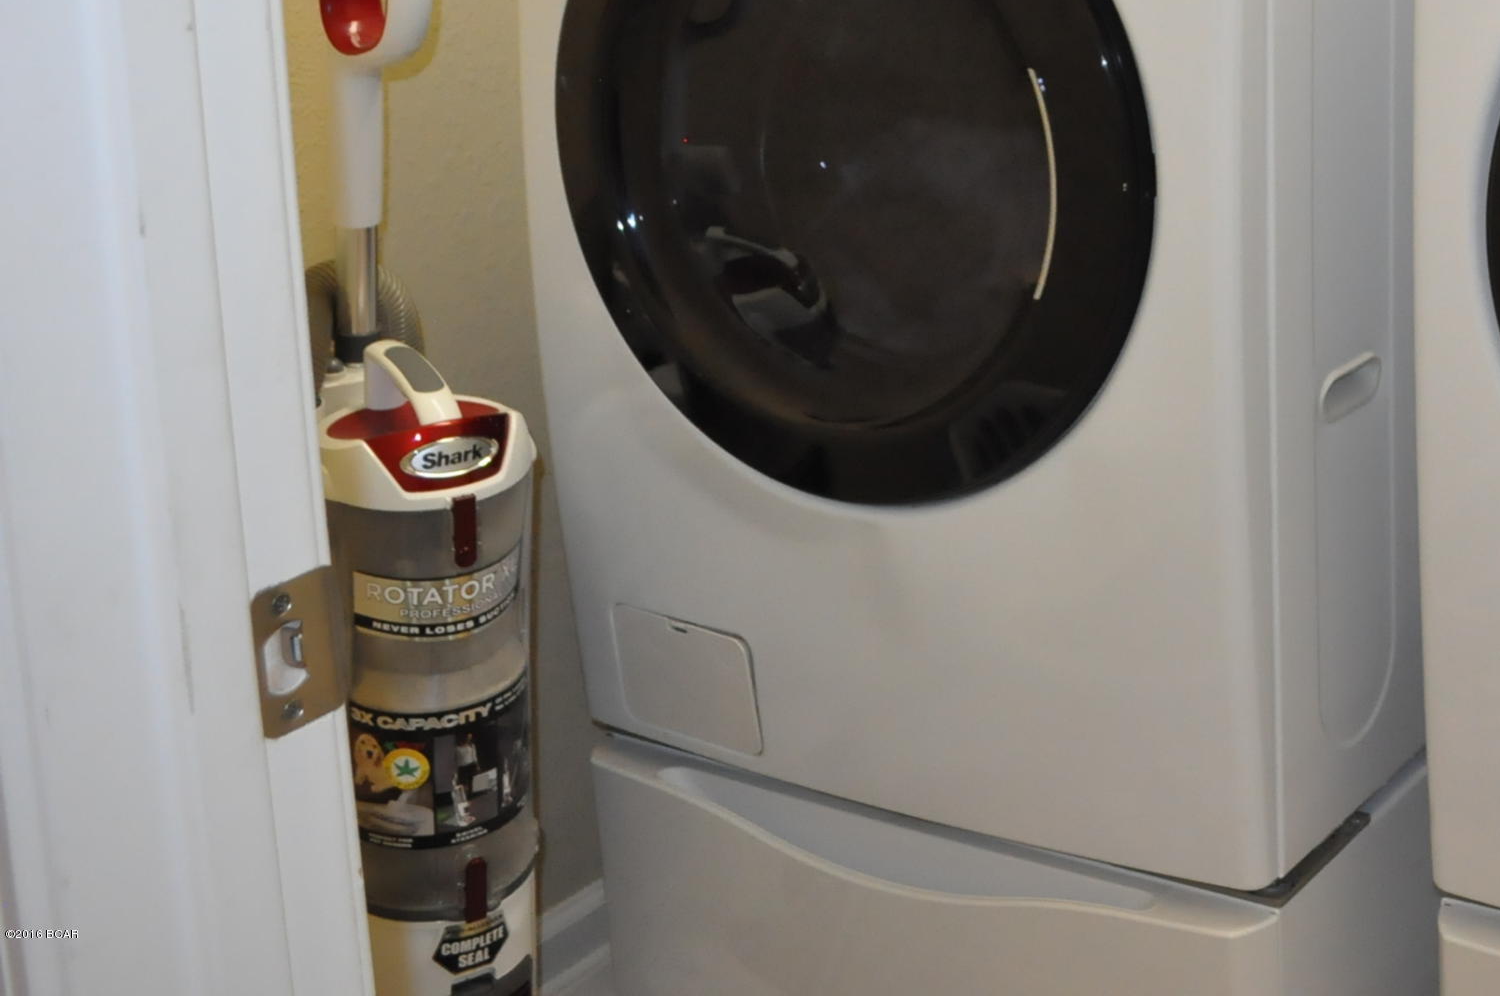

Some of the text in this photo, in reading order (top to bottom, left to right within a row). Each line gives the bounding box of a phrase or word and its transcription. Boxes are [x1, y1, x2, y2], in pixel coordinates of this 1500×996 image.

[422, 445, 483, 470] Shark
[367, 572, 496, 606] ROTATOR
[372, 621, 420, 635] NEVER
[425, 620, 475, 635] LOSES
[376, 701, 492, 732] CAPACITY
[441, 925, 505, 957] COMPLETE
[458, 947, 491, 968] SEAL
